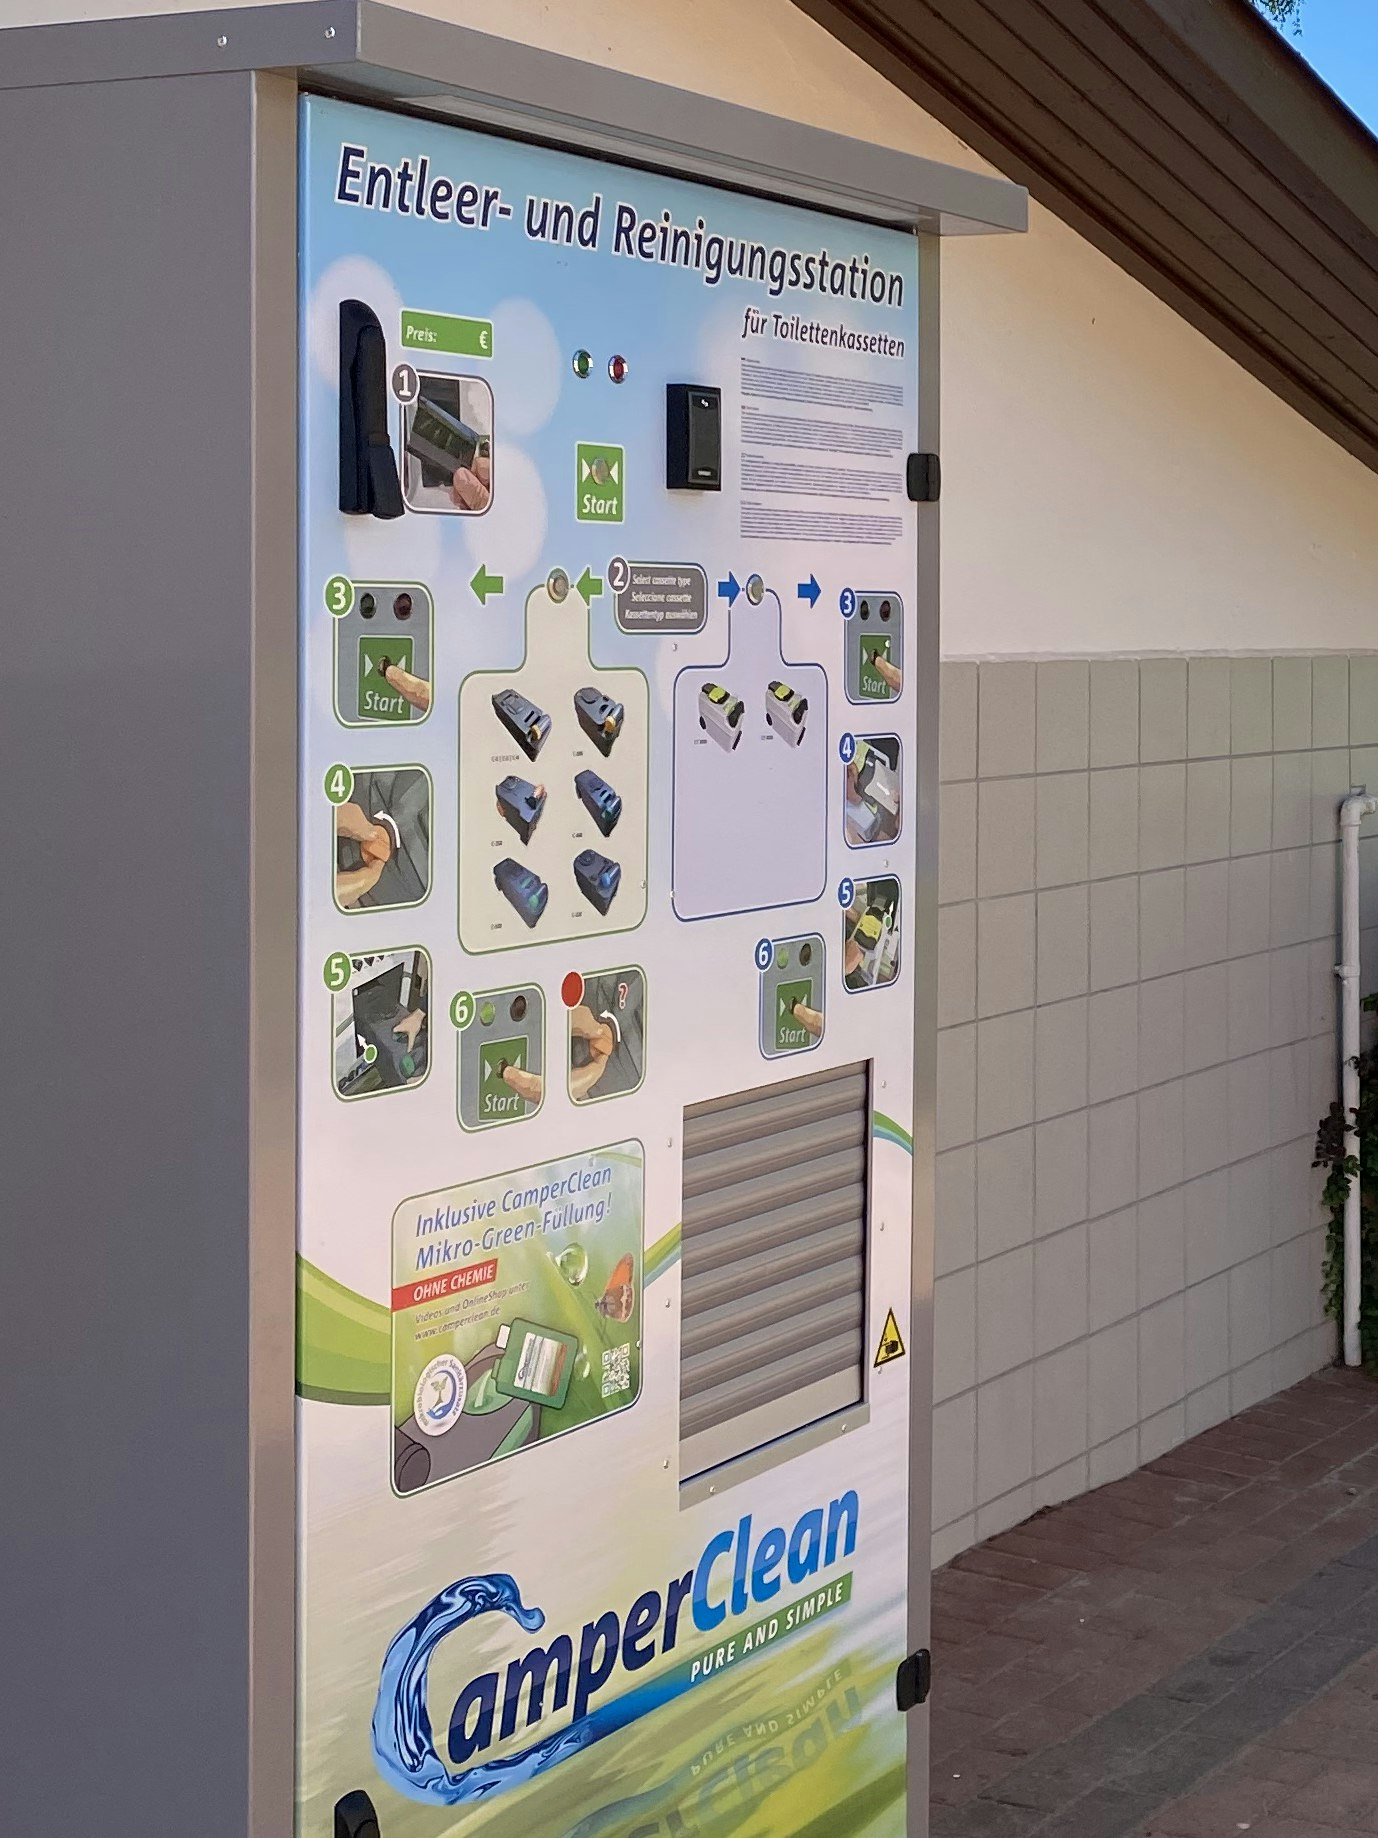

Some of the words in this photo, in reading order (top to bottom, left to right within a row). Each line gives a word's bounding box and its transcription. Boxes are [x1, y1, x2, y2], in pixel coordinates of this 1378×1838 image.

[336, 144, 512, 229] Entleer-
[525, 194, 602, 248] und
[613, 203, 904, 307] Reinigungsstation
[405, 325, 438, 343] Preis:
[479, 330, 488, 350] €
[741, 307, 767, 339] für
[773, 313, 905, 358] Toilettenkassetten
[399, 369, 411, 397] 1
[582, 493, 618, 515] Start
[613, 562, 625, 587] 2
[332, 582, 347, 610] 3
[843, 591, 852, 614] 3
[862, 675, 887, 695] Start
[363, 690, 404, 714] Start
[841, 737, 851, 758] 4
[330, 769, 345, 797] 4
[842, 882, 850, 904] 5
[758, 942, 768, 966] 6
[330, 957, 345, 987] 5
[455, 996, 468, 1023] 6
[617, 982, 629, 1010] ?
[778, 1025, 806, 1044] Start
[483, 1092, 520, 1113] Start
[415, 1199, 496, 1237] Inklusive
[502, 1167, 612, 1213] CamperClean
[415, 1192, 612, 1271] Mikro-Green-Füllung!
[413, 1278, 448, 1302] OHNE
[450, 1264, 495, 1290] CHEMIE
[690, 1640, 736, 1683] PURE
[742, 1618, 779, 1654] AND
[786, 1582, 844, 1630] SIMPLE
[371, 1489, 859, 1806] CamperClean
